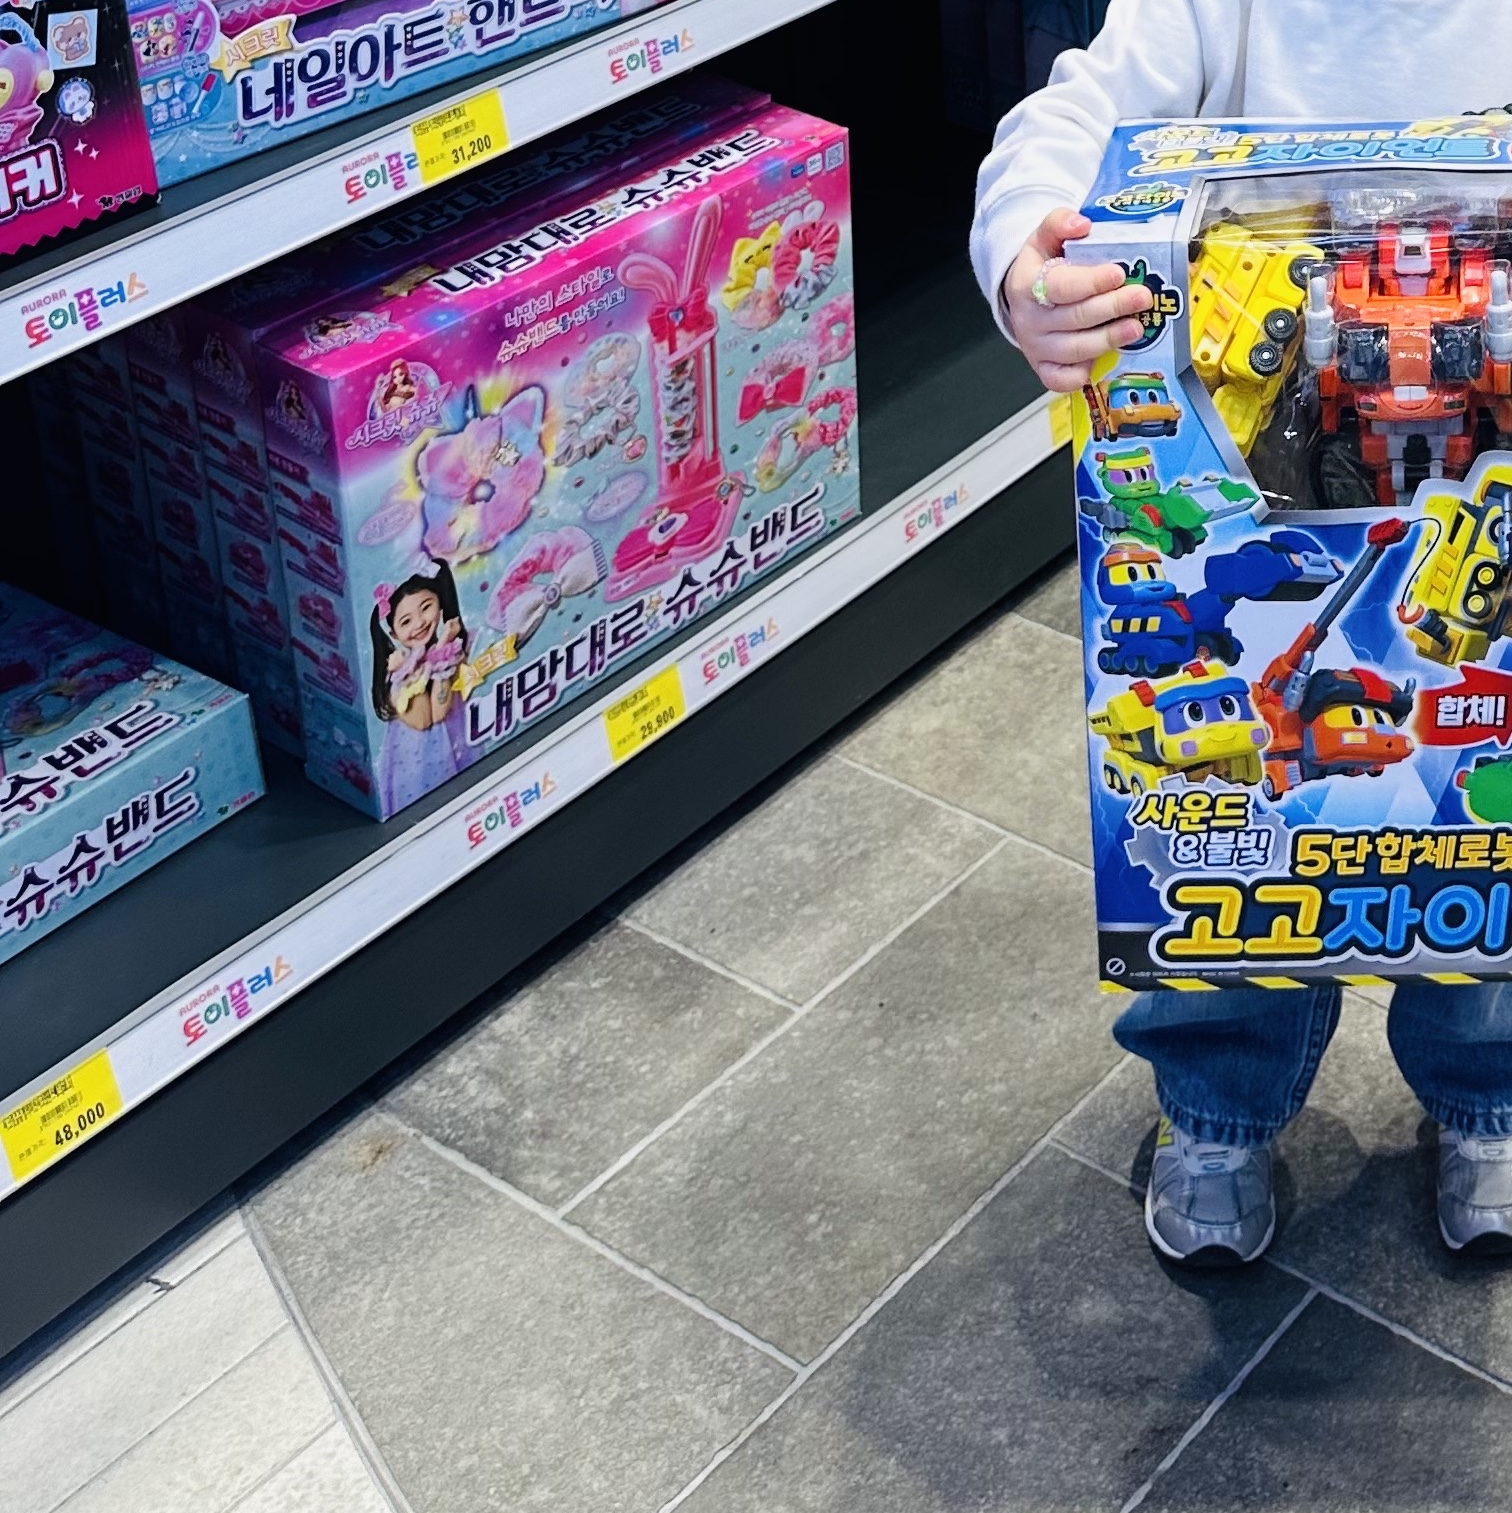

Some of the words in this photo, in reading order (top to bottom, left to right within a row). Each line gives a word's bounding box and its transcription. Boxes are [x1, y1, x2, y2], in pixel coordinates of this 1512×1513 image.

[226, 24, 282, 68] 시크릿
[240, 12, 450, 124] 네일아트
[607, 36, 641, 56] AURORA
[608, 30, 696, 86] 토이플러스
[340, 152, 381, 174] AURORA
[451, 133, 493, 165] 31,200
[1145, 136, 1497, 169] 고고자이언트
[430, 203, 614, 294] 내맘대로
[620, 128, 784, 213] 슈슈밴드
[20, 288, 68, 316] AURORA
[24, 271, 150, 349] 토이플러스
[504, 294, 554, 328] 나만의
[556, 266, 616, 310] 스타일로
[498, 316, 572, 364] 슈슈밴드를
[572, 287, 626, 333] 만들어요!
[350, 414, 405, 449] 시크릿
[468, 598, 651, 743] 내맘대로
[662, 485, 825, 625] 슈슈밴드
[701, 617, 781, 686] 토이플러스
[640, 705, 676, 741] 29,900
[1435, 694, 1508, 730] 합체!
[463, 794, 501, 824] AURORA
[466, 772, 559, 852] 토이플러스
[1137, 792, 1252, 830] 사운드
[3, 769, 198, 927] 슈슈밴드
[1295, 830, 1373, 877] 5단
[177, 982, 222, 1019] AURORA
[180, 954, 295, 1048] 토이플러스
[53, 1101, 107, 1148] 48,000
